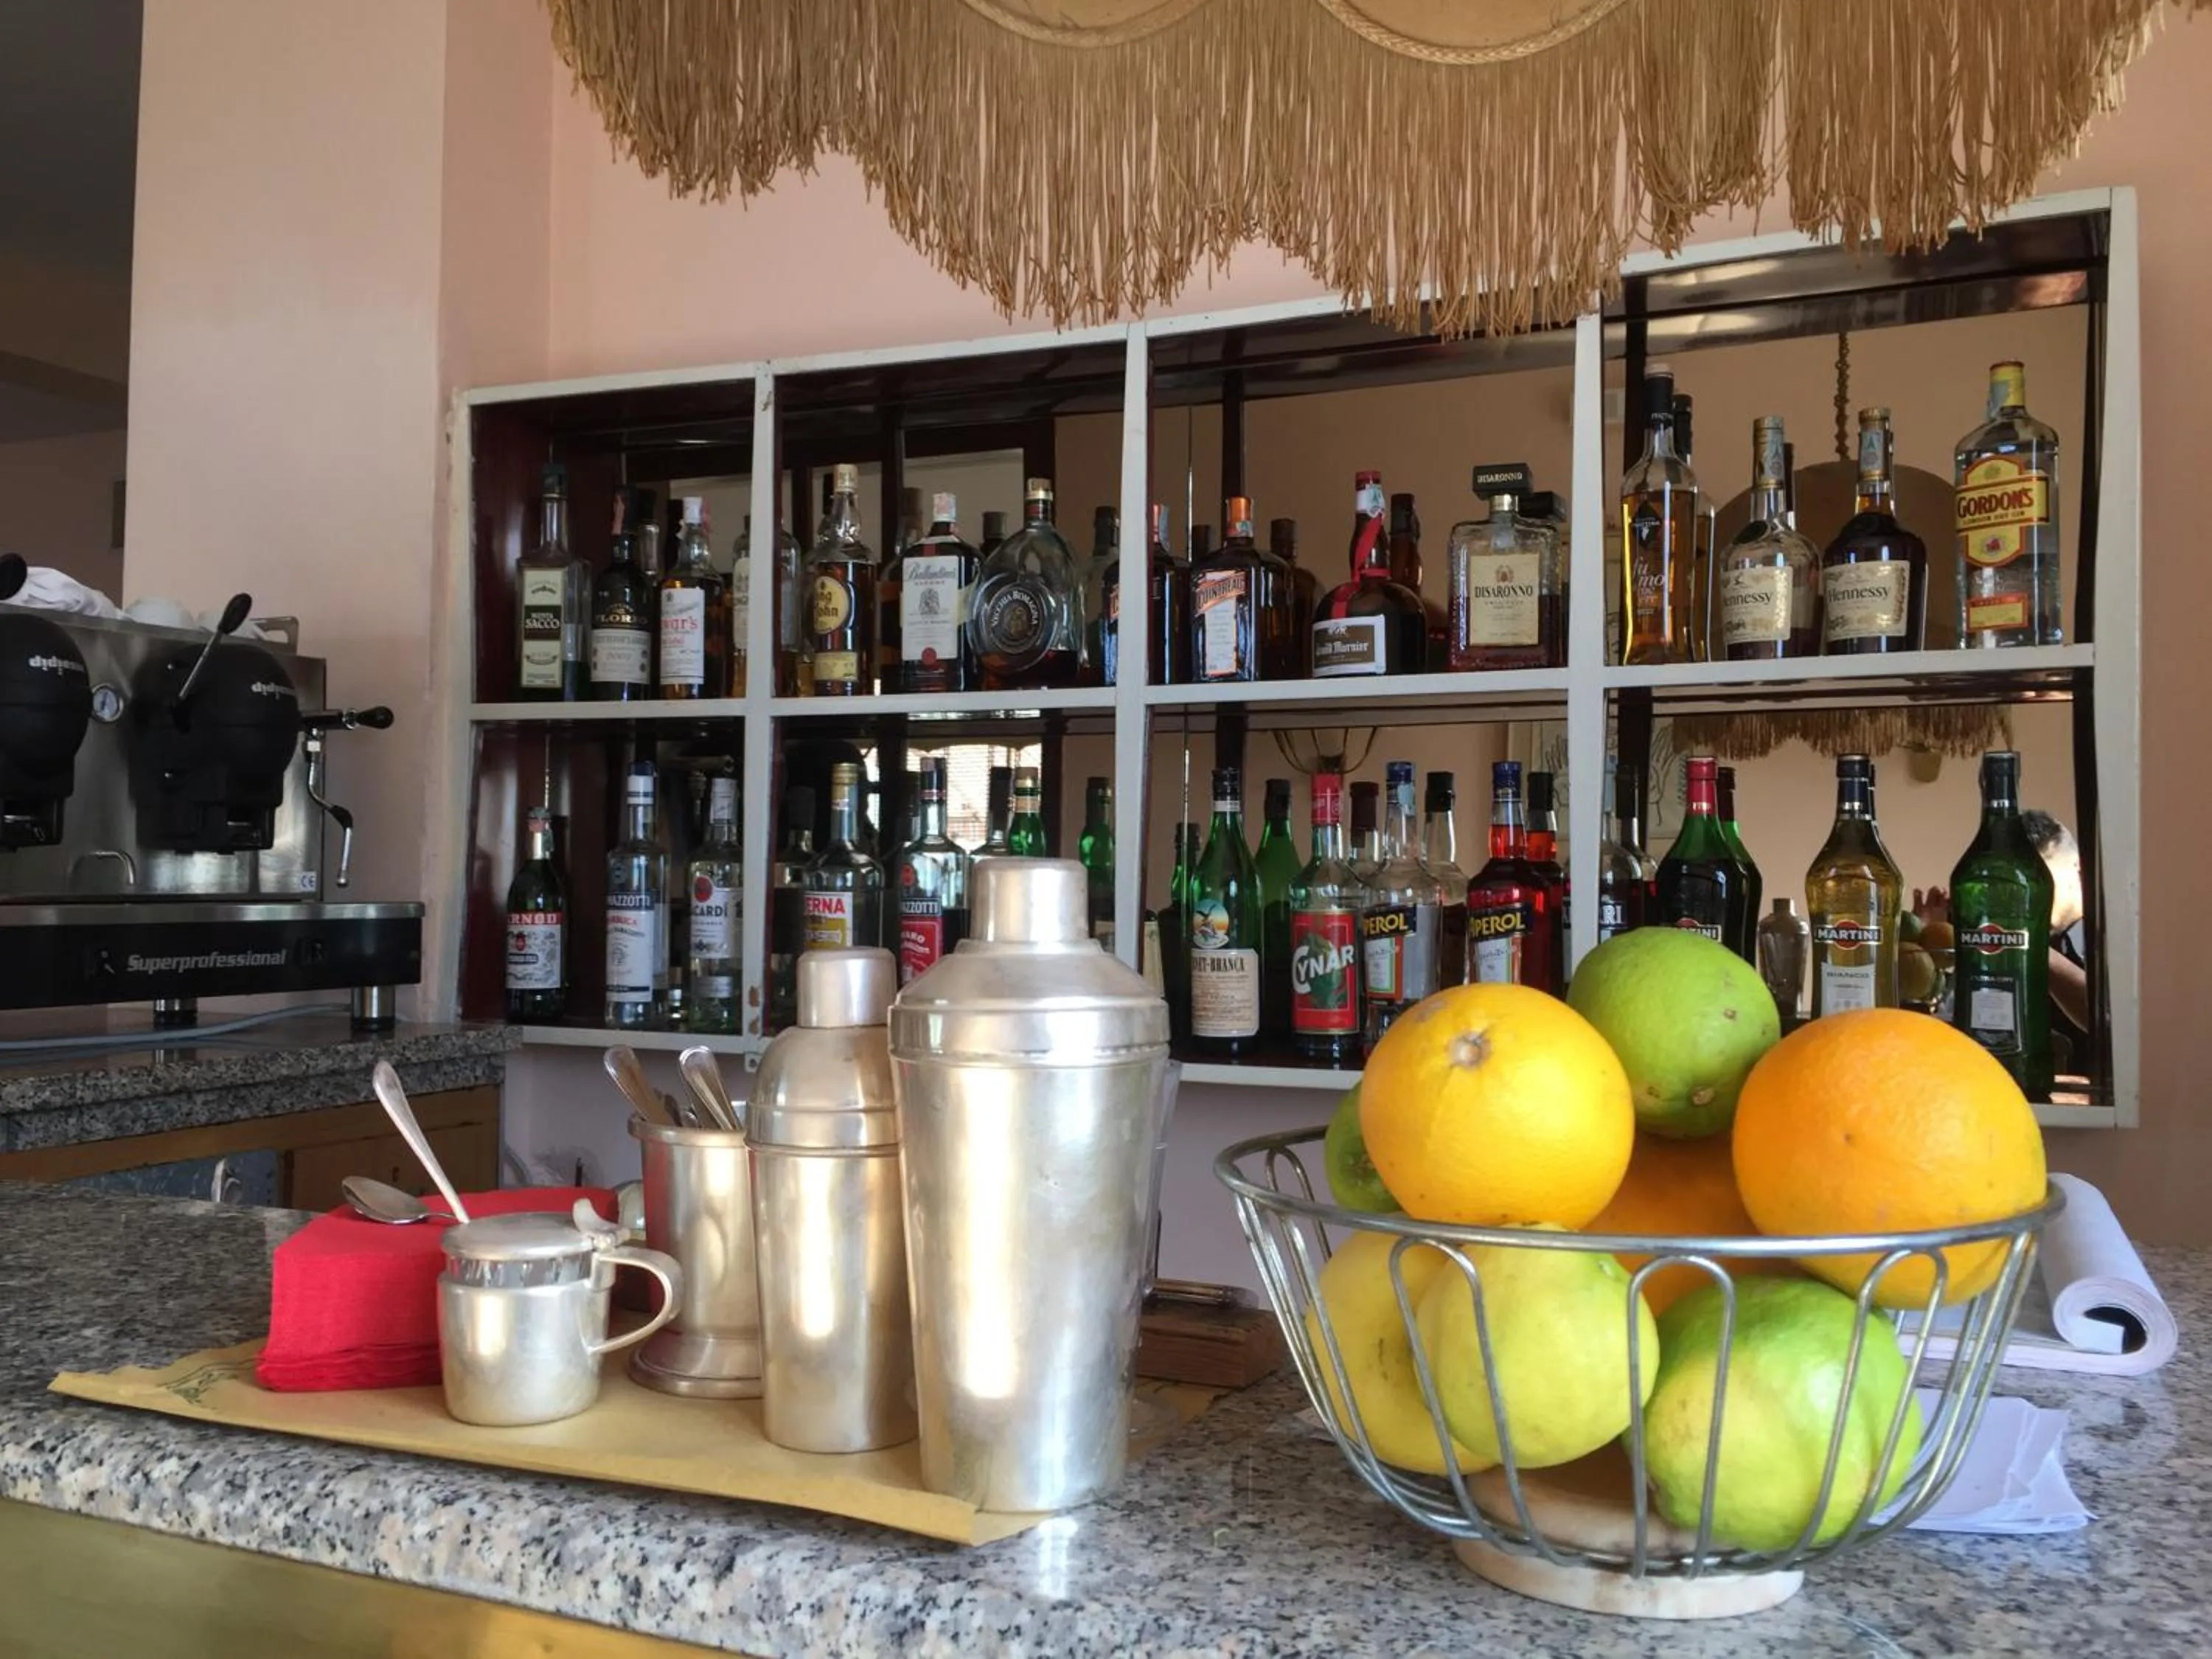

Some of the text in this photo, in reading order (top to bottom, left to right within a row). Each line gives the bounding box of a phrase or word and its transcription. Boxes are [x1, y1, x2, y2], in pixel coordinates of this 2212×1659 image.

[1477, 471, 1523, 483] DISARONNO
[1958, 487, 2034, 518] GORDON'S
[1474, 585, 1534, 599] DISARONNO
[1723, 590, 1773, 607] ennessy
[1829, 585, 1893, 603] Hennessy
[525, 619, 560, 629] SACCO
[806, 897, 846, 915] ERNA
[1818, 928, 1878, 940] MARTINI
[1961, 933, 2023, 945] MARTINI
[127, 949, 287, 975] Superprofessional
[1292, 942, 1354, 994] CYNAR
